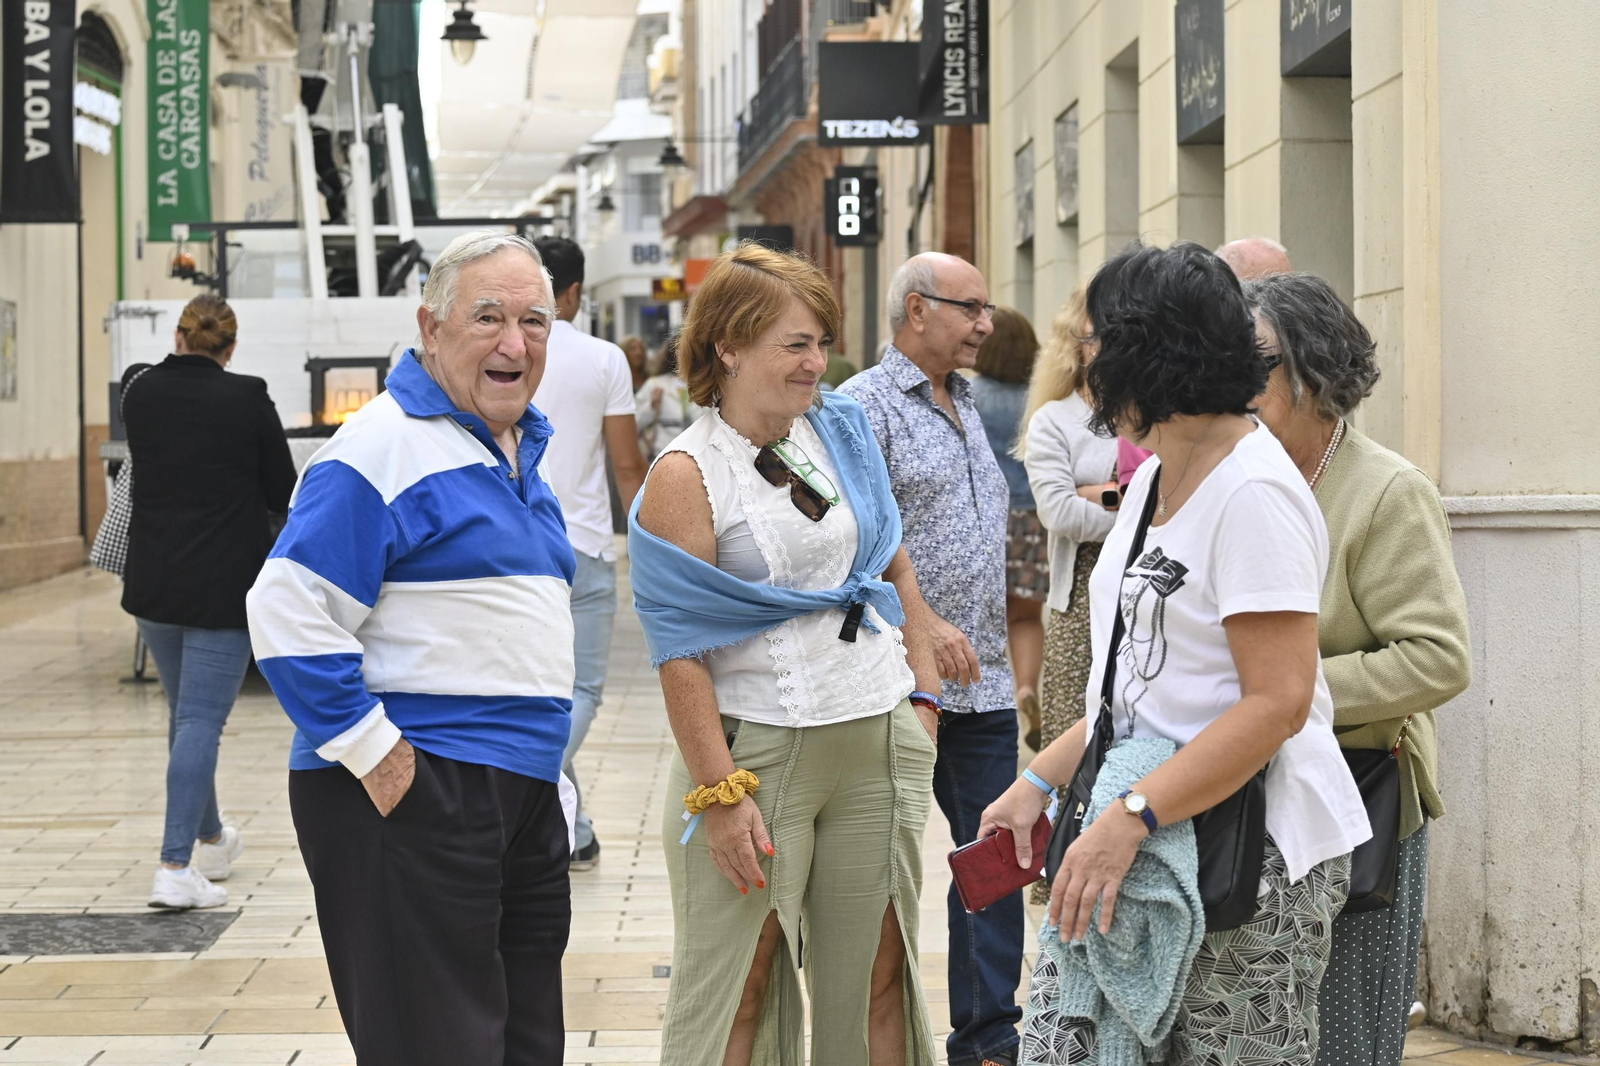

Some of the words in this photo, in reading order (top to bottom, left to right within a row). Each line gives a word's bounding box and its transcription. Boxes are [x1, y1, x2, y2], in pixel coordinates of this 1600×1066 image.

[943, 0, 965, 42] REA
[24, 49, 50, 73] Y
[156, 50, 177, 85] DE
[944, 48, 966, 116] LYNCIS
[24, 79, 50, 162] LOLA
[157, 91, 178, 160] CASA
[180, 29, 201, 169] CARCASAS
[157, 168, 178, 207] LA
